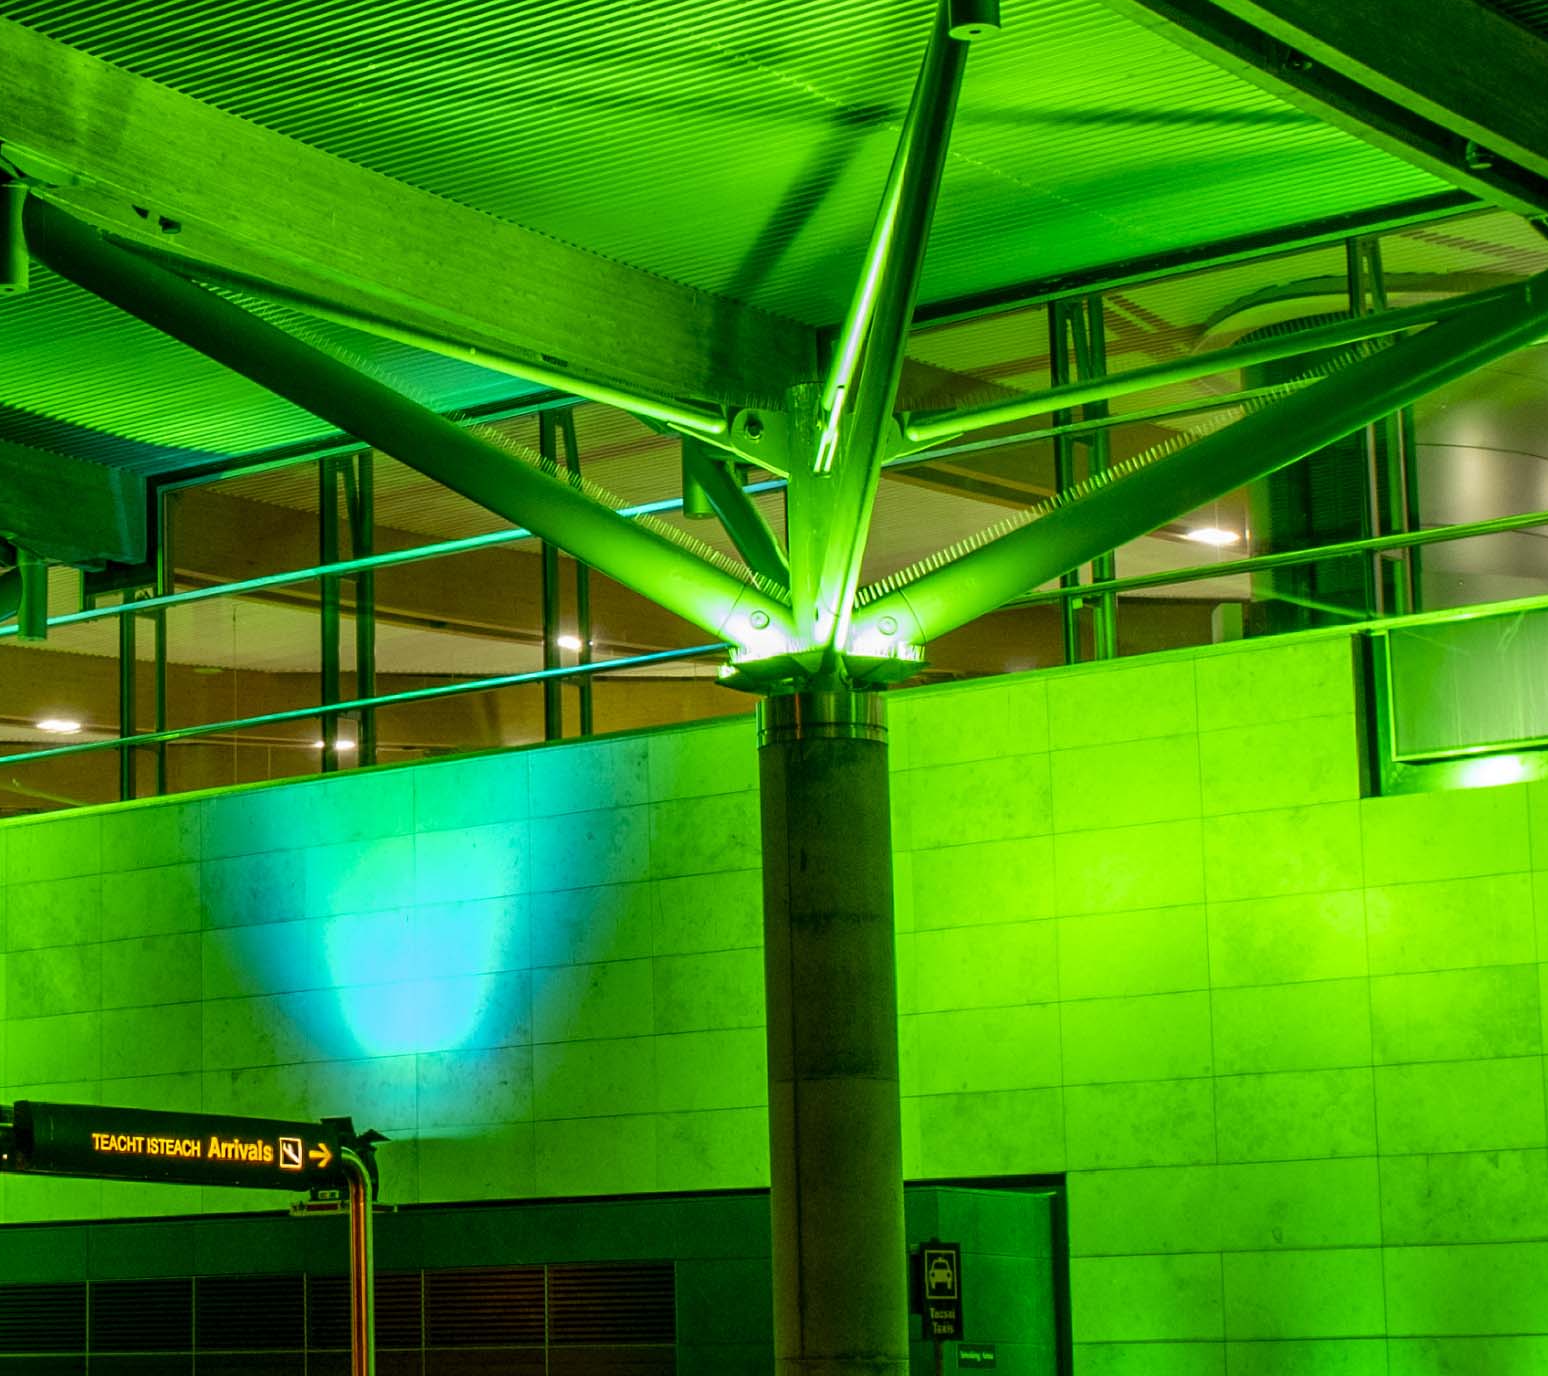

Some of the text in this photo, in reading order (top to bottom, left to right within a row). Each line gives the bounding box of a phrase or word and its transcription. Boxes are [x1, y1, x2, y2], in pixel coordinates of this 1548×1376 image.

[92, 1133, 273, 1163] TEACHT ISTEACH Arrivals
[929, 1307, 956, 1320] Tacsai
[932, 1321, 955, 1335] Taxis
